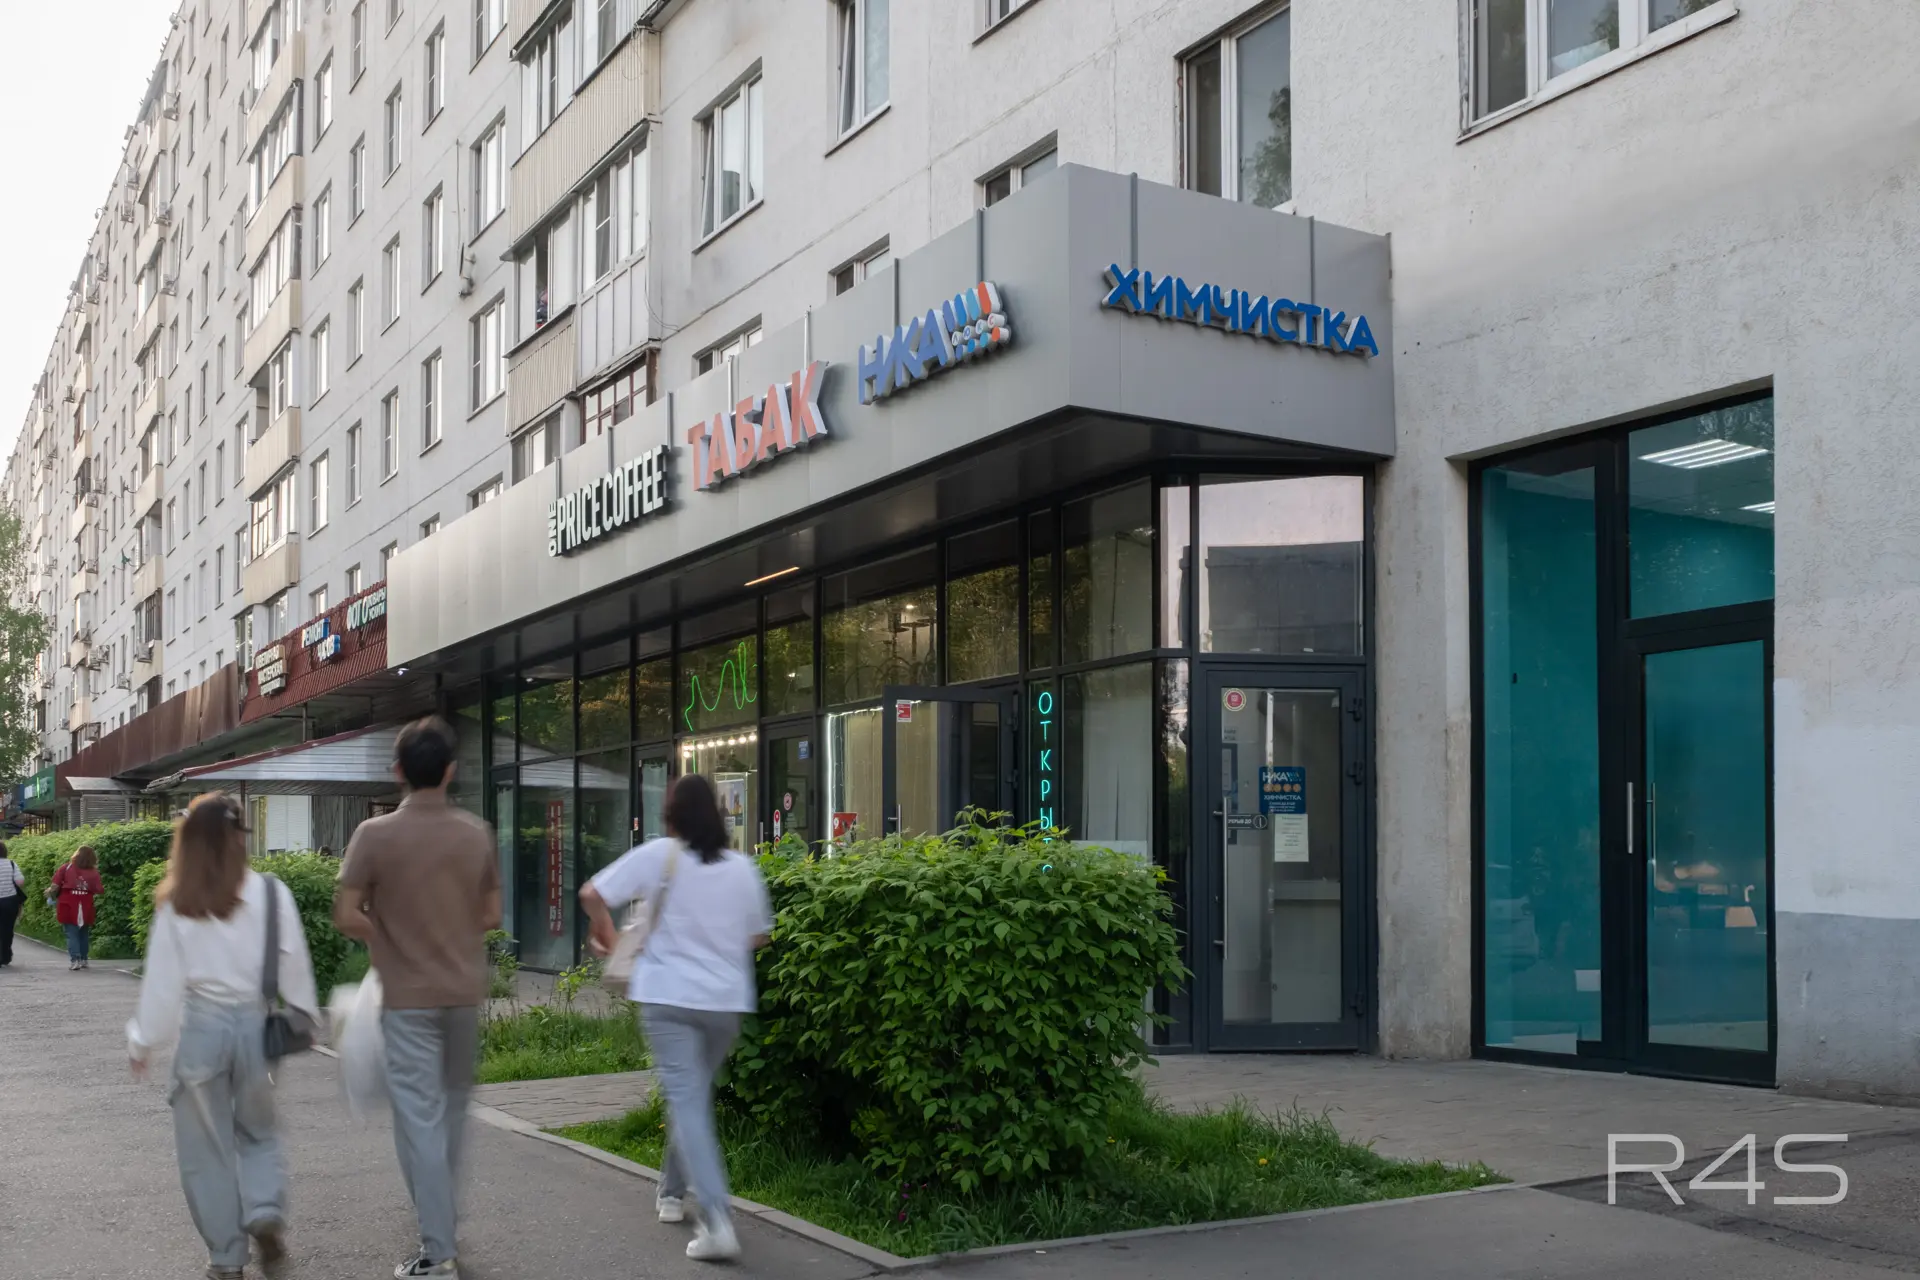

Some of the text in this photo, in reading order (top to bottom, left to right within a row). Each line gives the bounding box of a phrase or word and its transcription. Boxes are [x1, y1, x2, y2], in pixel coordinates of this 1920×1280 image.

[858, 308, 954, 405] НИКА
[1102, 263, 1379, 357] ХИМЧИСТКА
[688, 360, 826, 491] ТАБАК
[548, 500, 557, 557] ONE
[557, 444, 666, 554] PRICE COFFEE
[1038, 691, 1053, 874] ОТКРЫ
